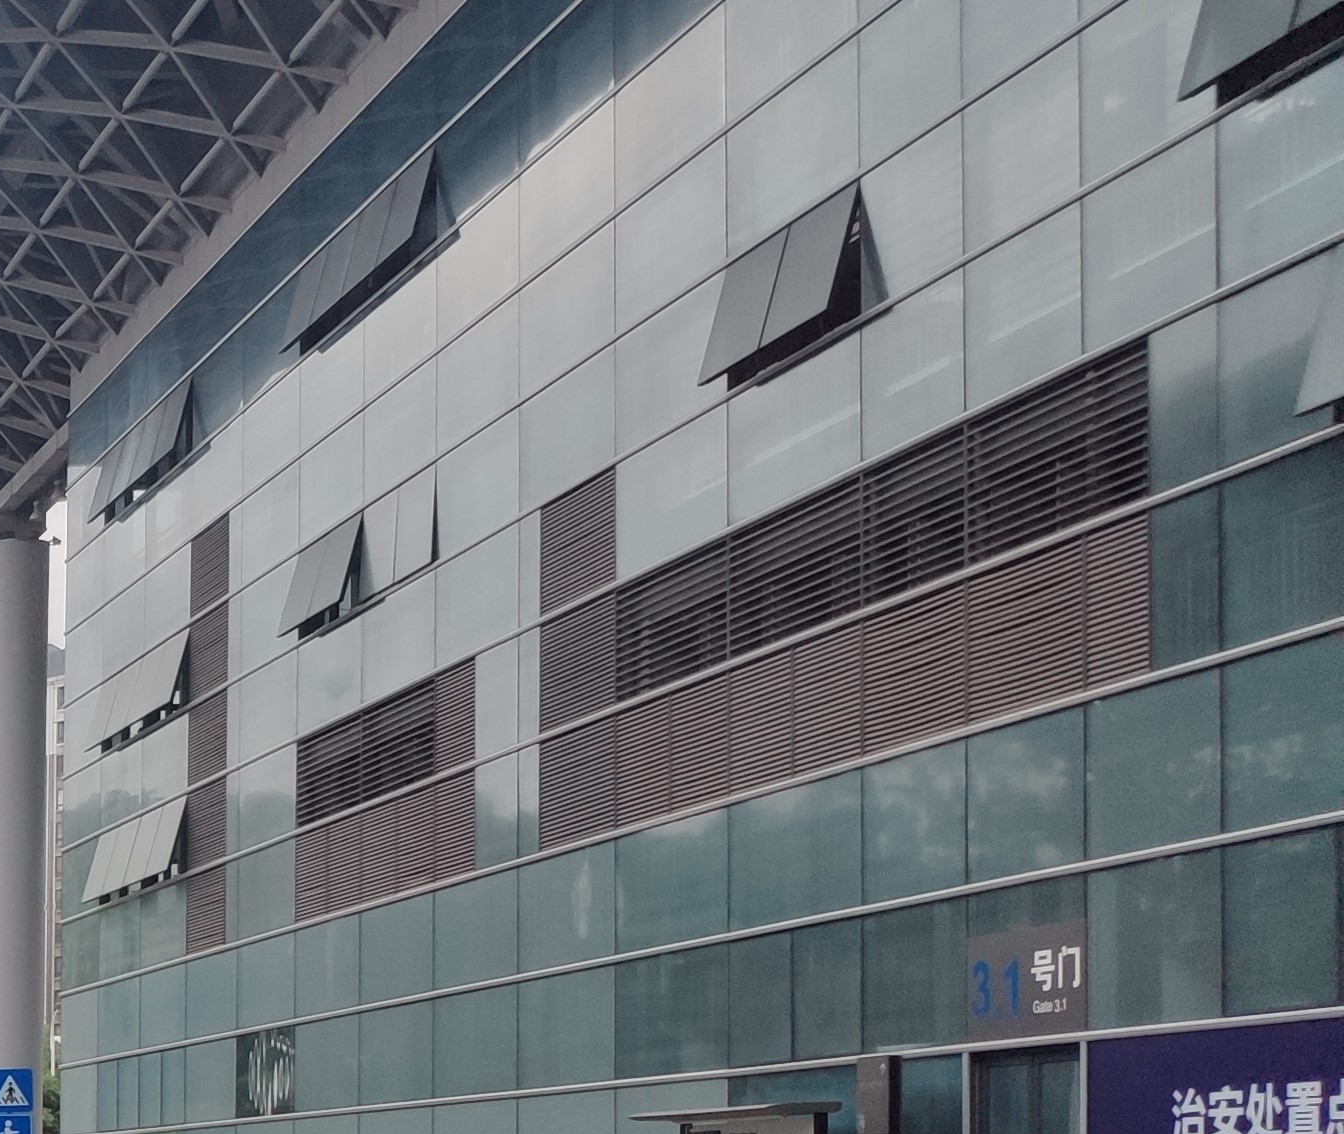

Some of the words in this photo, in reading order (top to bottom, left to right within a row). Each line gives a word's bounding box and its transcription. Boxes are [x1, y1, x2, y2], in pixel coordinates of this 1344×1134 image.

[1031, 945, 1081, 992] 号门
[1032, 999, 1053, 1014] Gate
[1054, 998, 1067, 1013] 3.1
